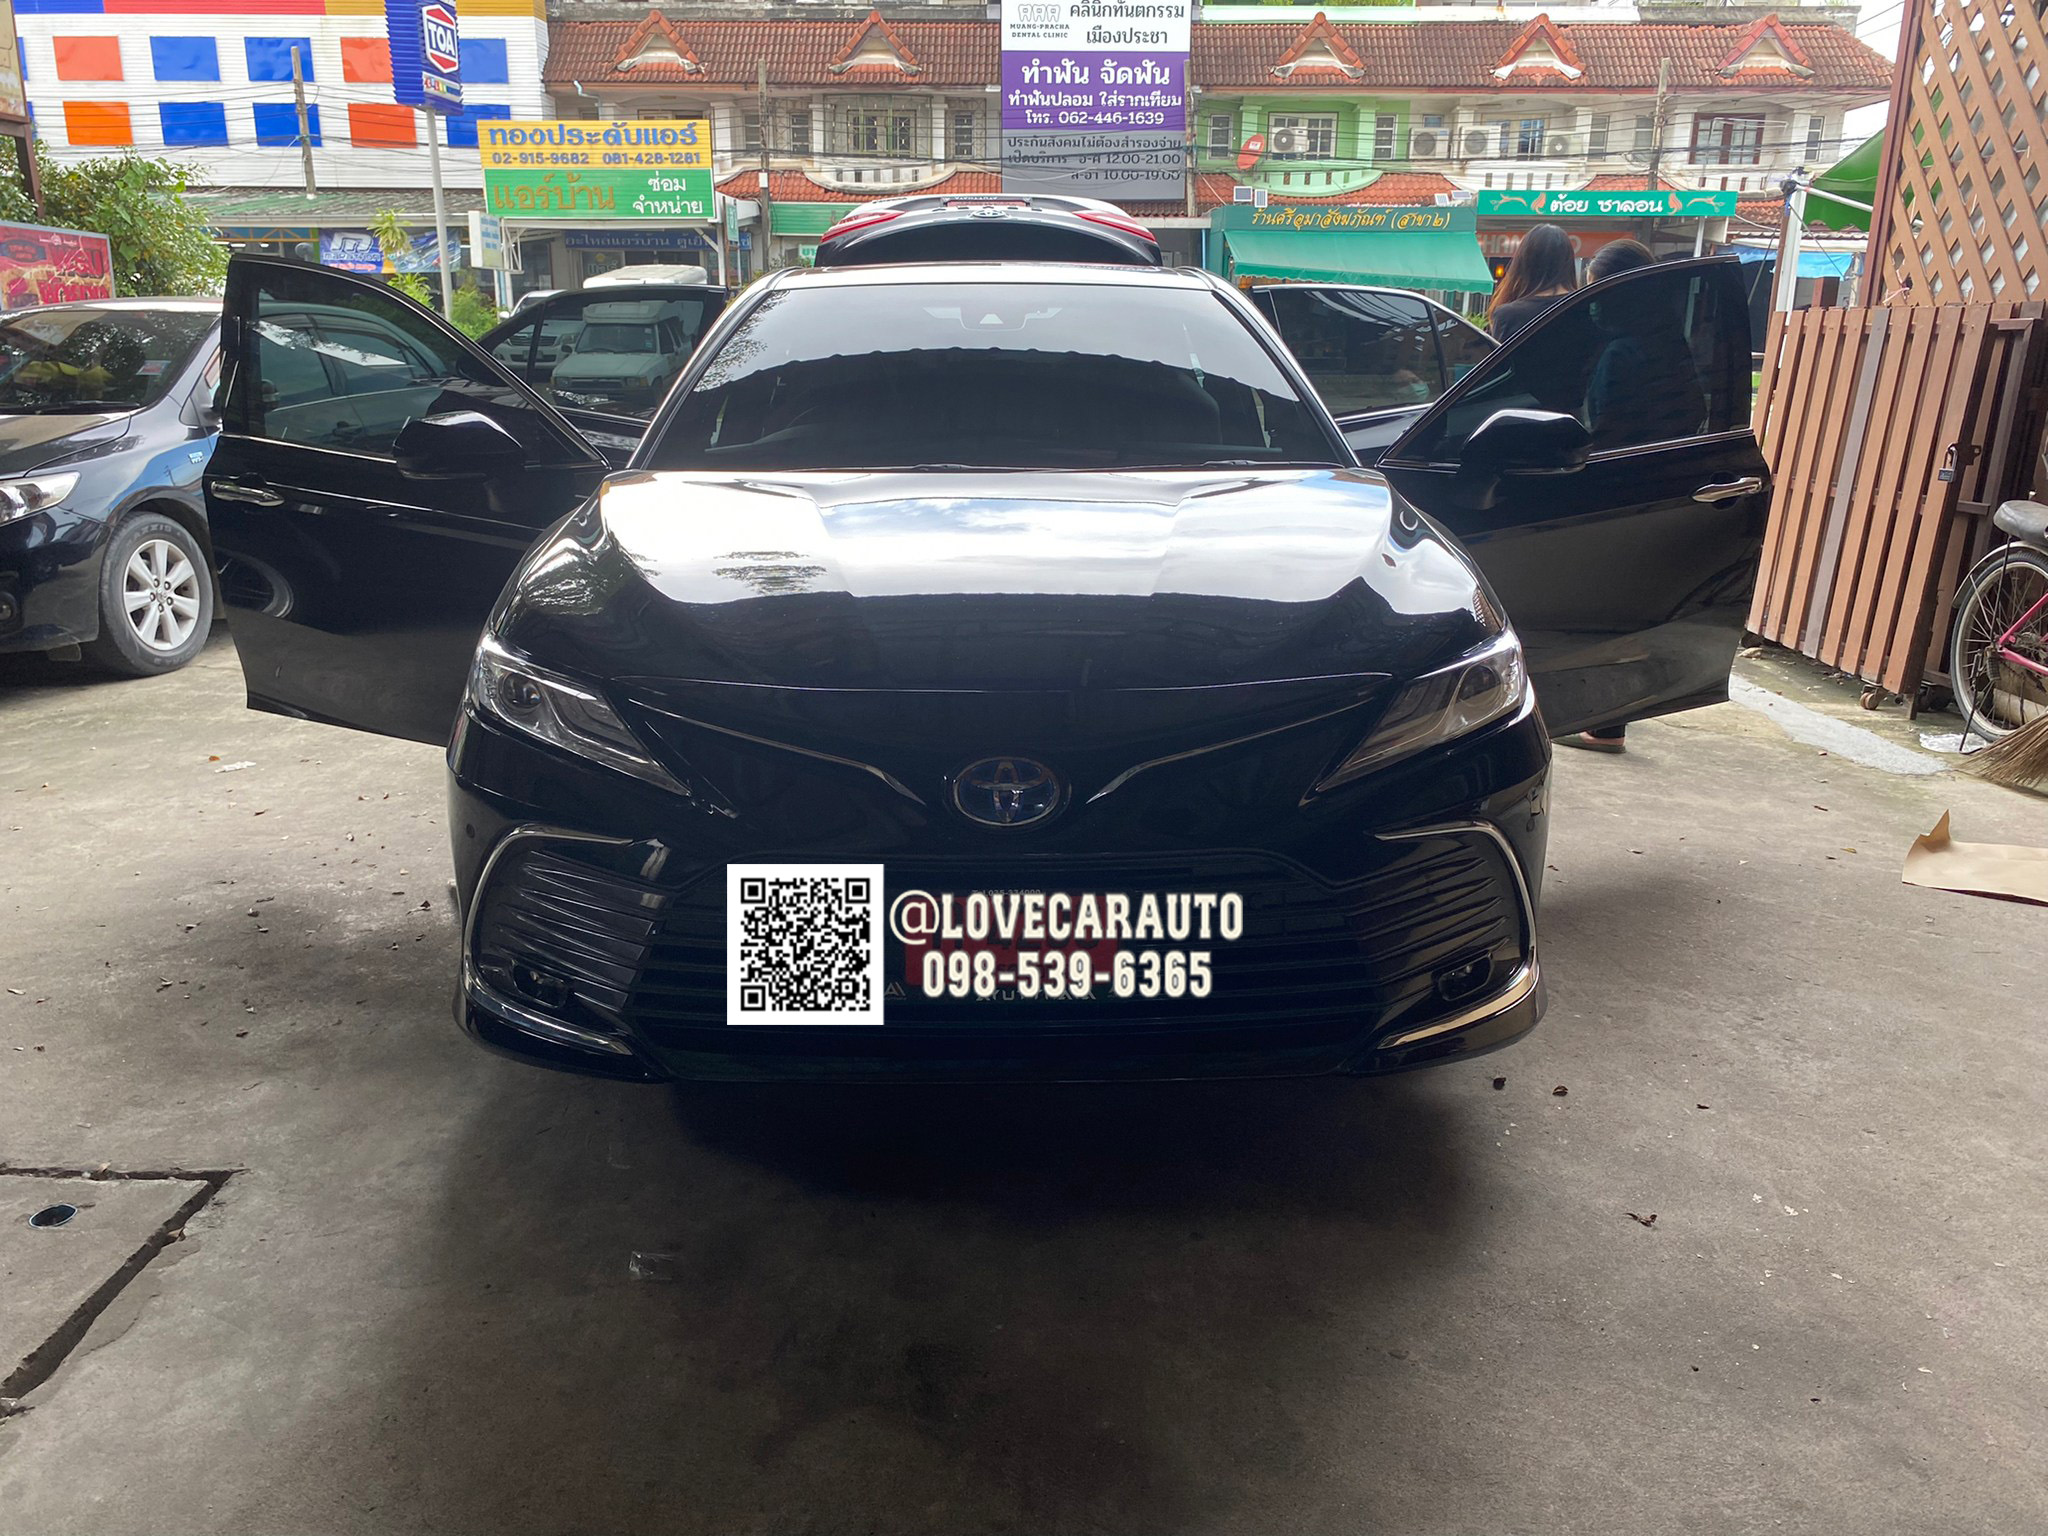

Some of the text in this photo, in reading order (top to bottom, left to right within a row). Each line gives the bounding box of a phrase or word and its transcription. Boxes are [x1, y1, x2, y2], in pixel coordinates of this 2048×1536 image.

[427, 20, 456, 57] TOA
[1086, 25, 1168, 44] เมืองประชา
[1021, 58, 1170, 85] ทำฟัน จัดฟัน
[1008, 89, 1182, 107] ทำฟันปลอม ใส่รากเทียม
[1025, 109, 1165, 125] โทร. 062-446-1639
[488, 121, 698, 146] ทองประดับแอร์
[1007, 135, 1182, 149] ประกันสังคมไม่ต้องสำรองจ่าย
[491, 152, 701, 165] 02-915-9682 081-428-1281
[1105, 152, 1181, 165] 12.00-21.00
[494, 171, 616, 210] แอร์บ้าน
[647, 170, 687, 192] ซ่อม
[632, 194, 704, 214] จำหน่าย
[1550, 193, 1589, 213] ต้อย
